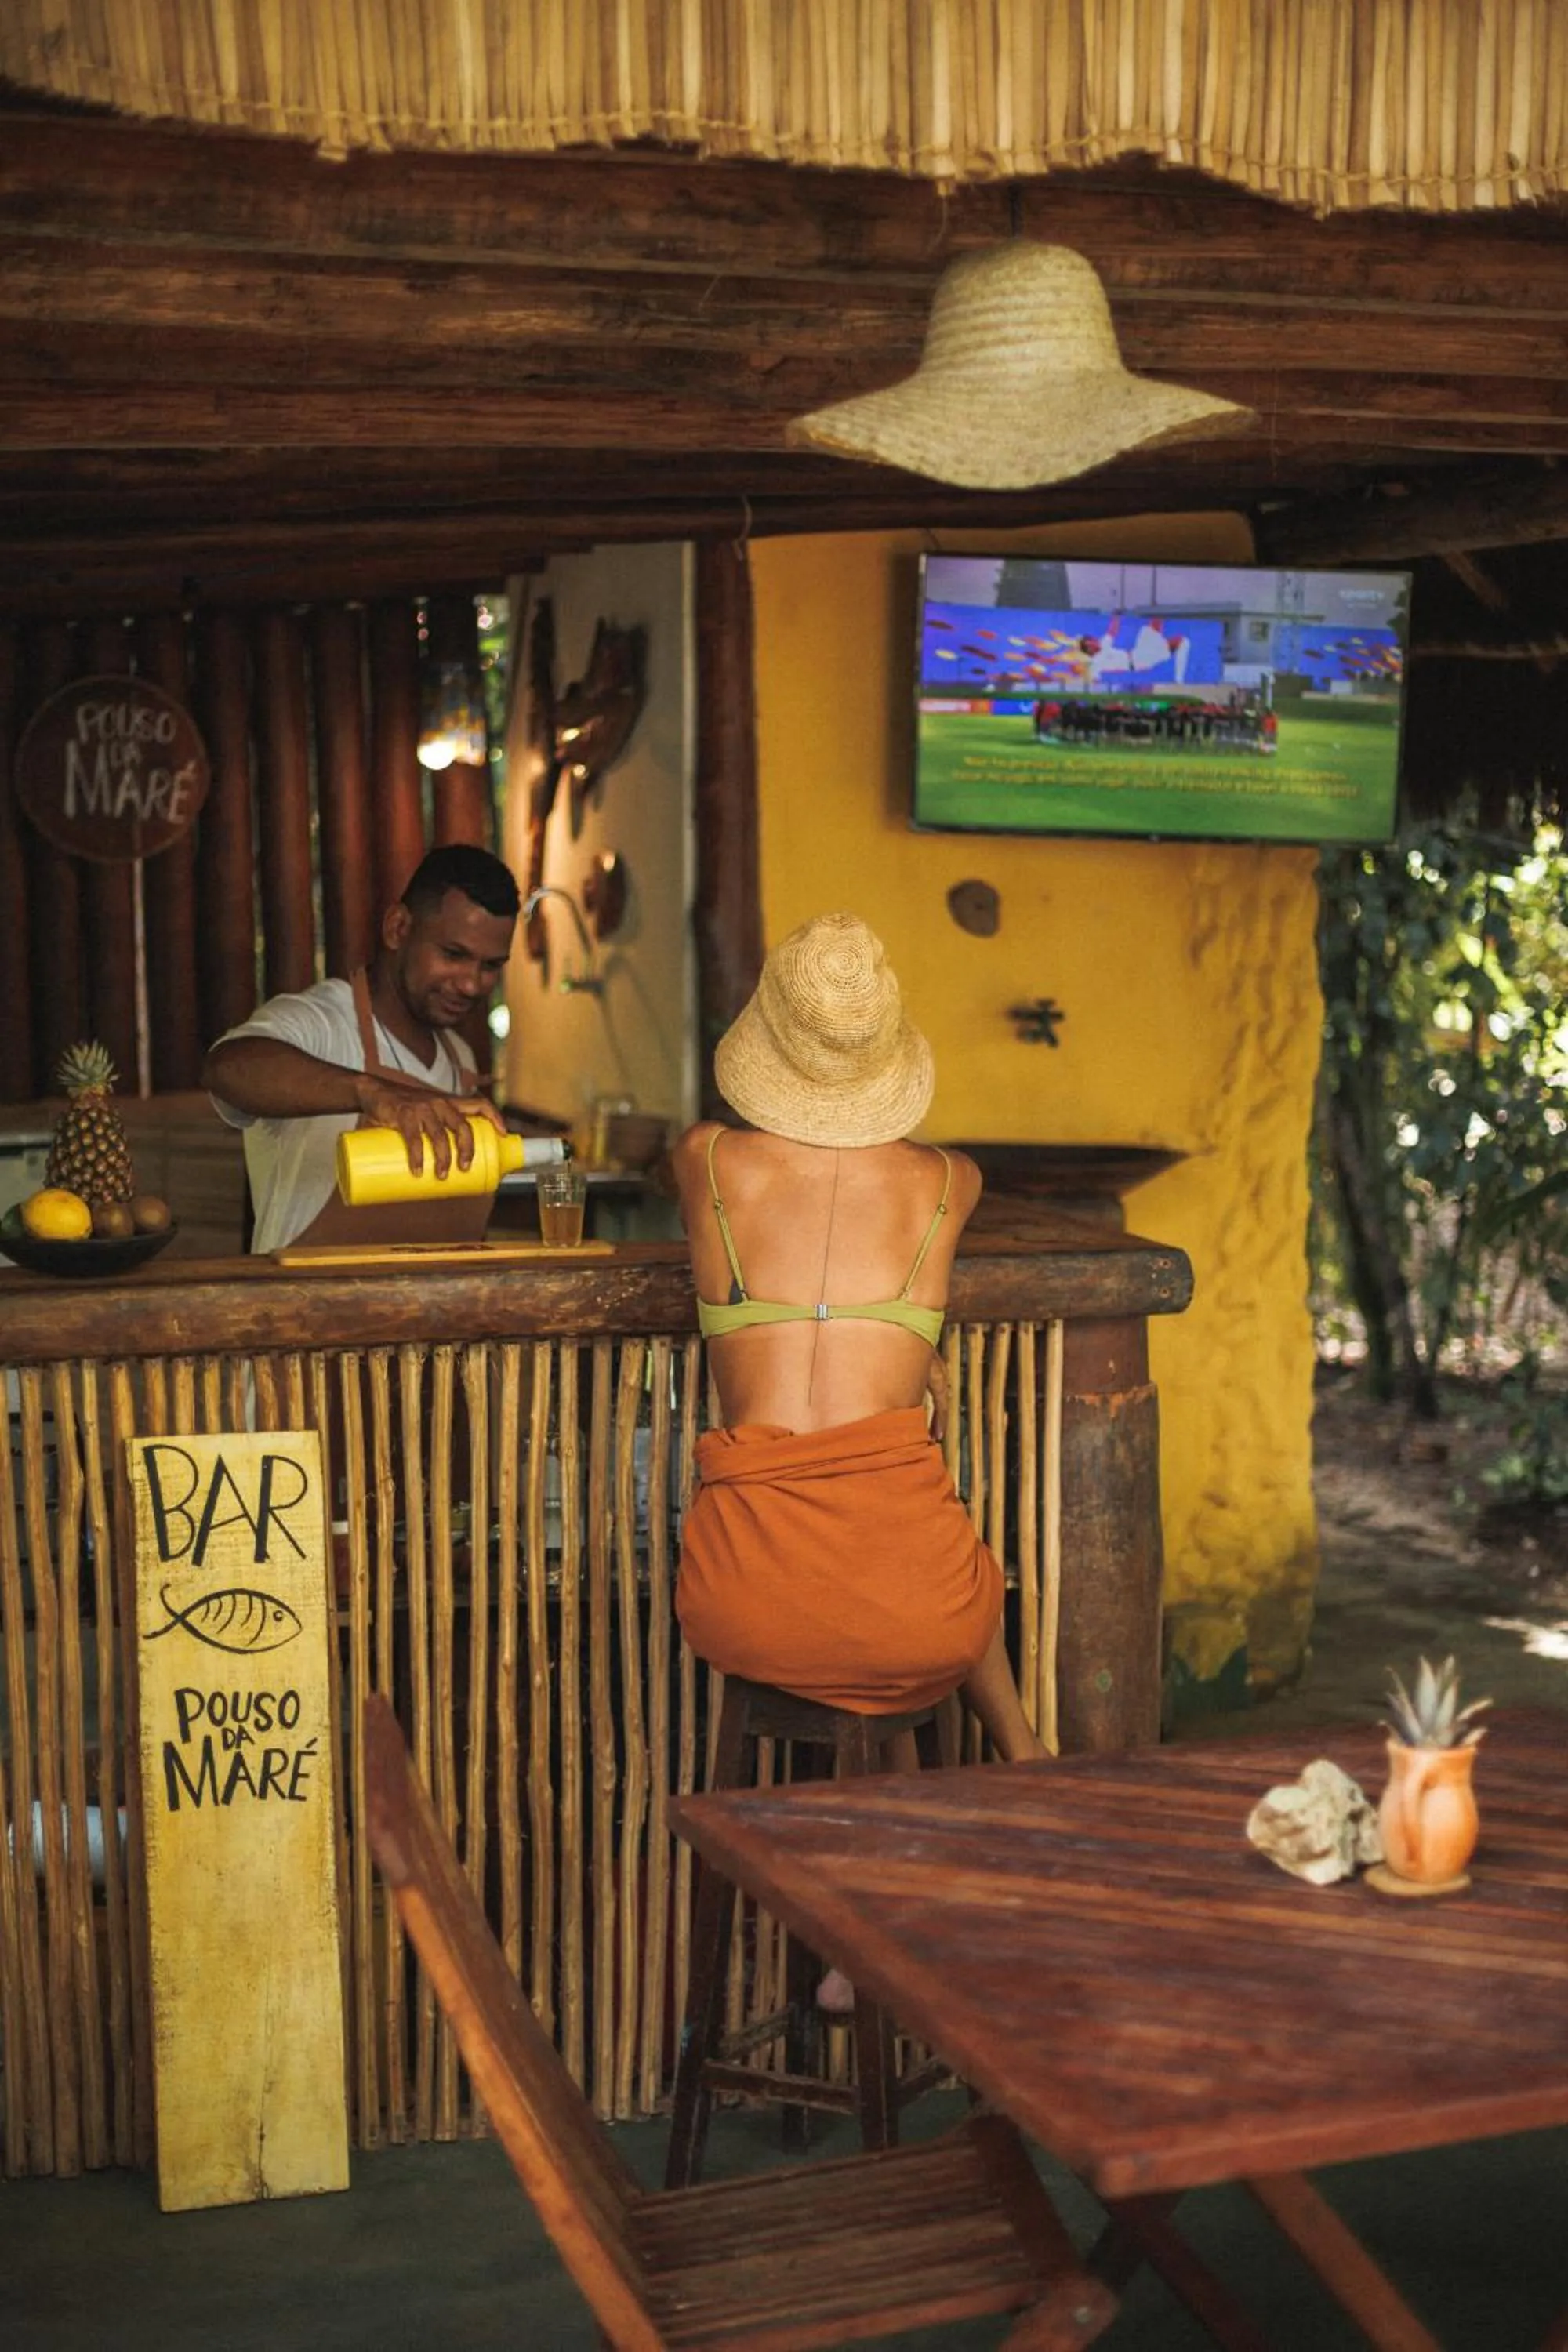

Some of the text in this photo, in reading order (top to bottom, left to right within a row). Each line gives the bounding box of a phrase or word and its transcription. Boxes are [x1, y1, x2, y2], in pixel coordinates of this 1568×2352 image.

[76, 702, 177, 744] POUSO
[64, 739, 197, 822] MARÉ
[142, 1444, 308, 1566] BAR
[174, 1687, 301, 1744] POUSO
[221, 1724, 256, 1751] DA
[163, 1734, 318, 1812] MARÉ
